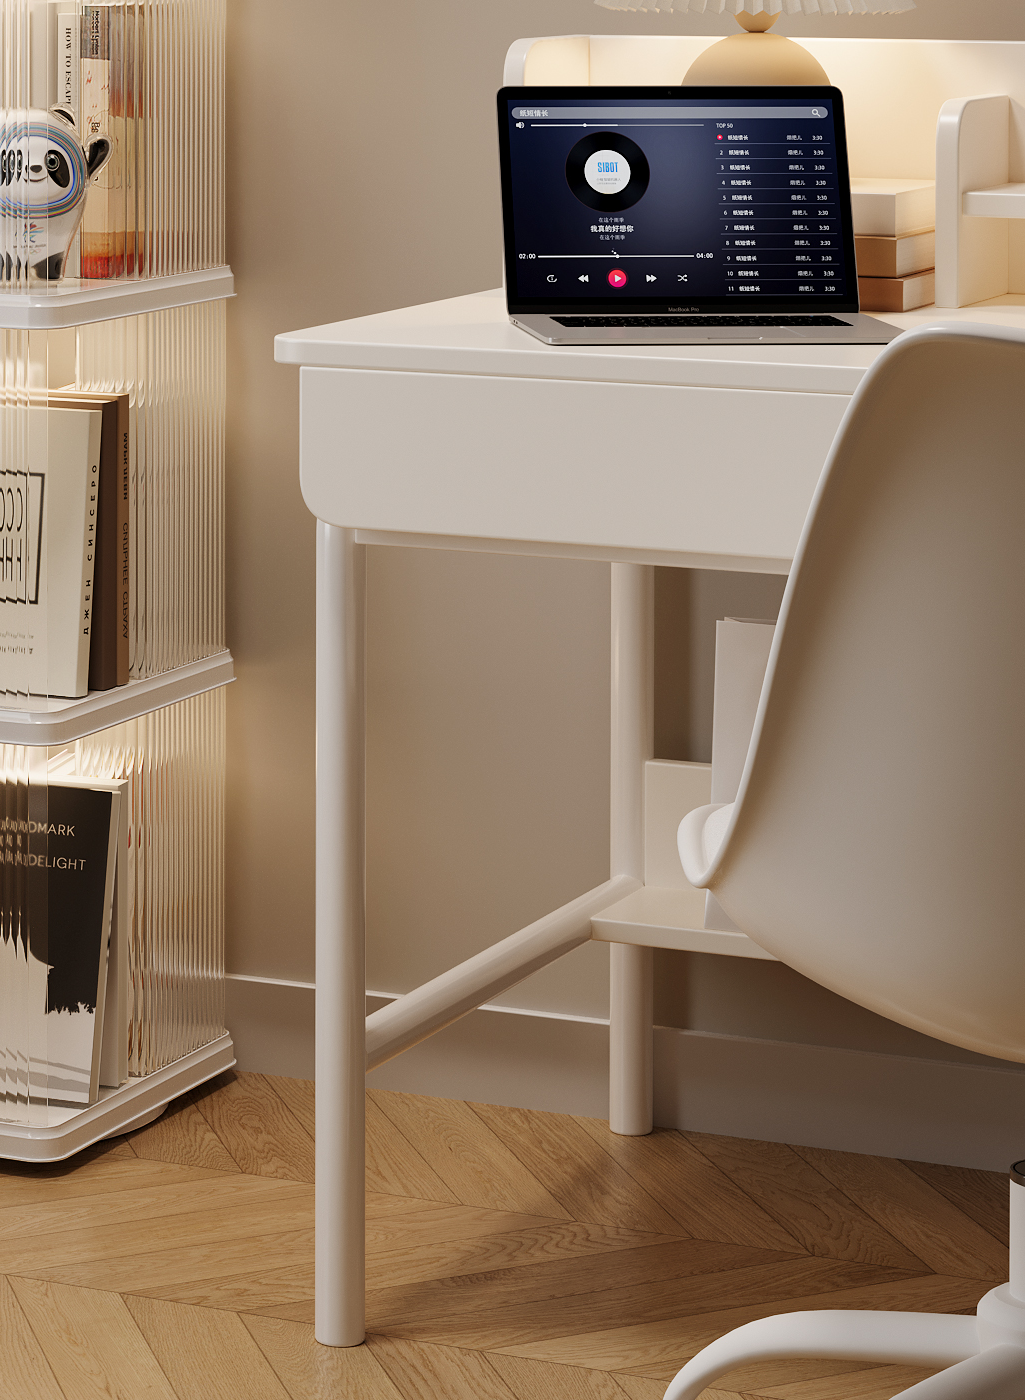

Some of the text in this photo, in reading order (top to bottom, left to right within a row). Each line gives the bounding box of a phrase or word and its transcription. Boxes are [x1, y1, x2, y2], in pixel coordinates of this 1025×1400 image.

[65, 55, 71, 68] TO
[597, 162, 618, 173] SIBOT
[83, 465, 97, 636] ДЖЕН СИНСЕРО
[28, 854, 86, 871] DELIGHT
